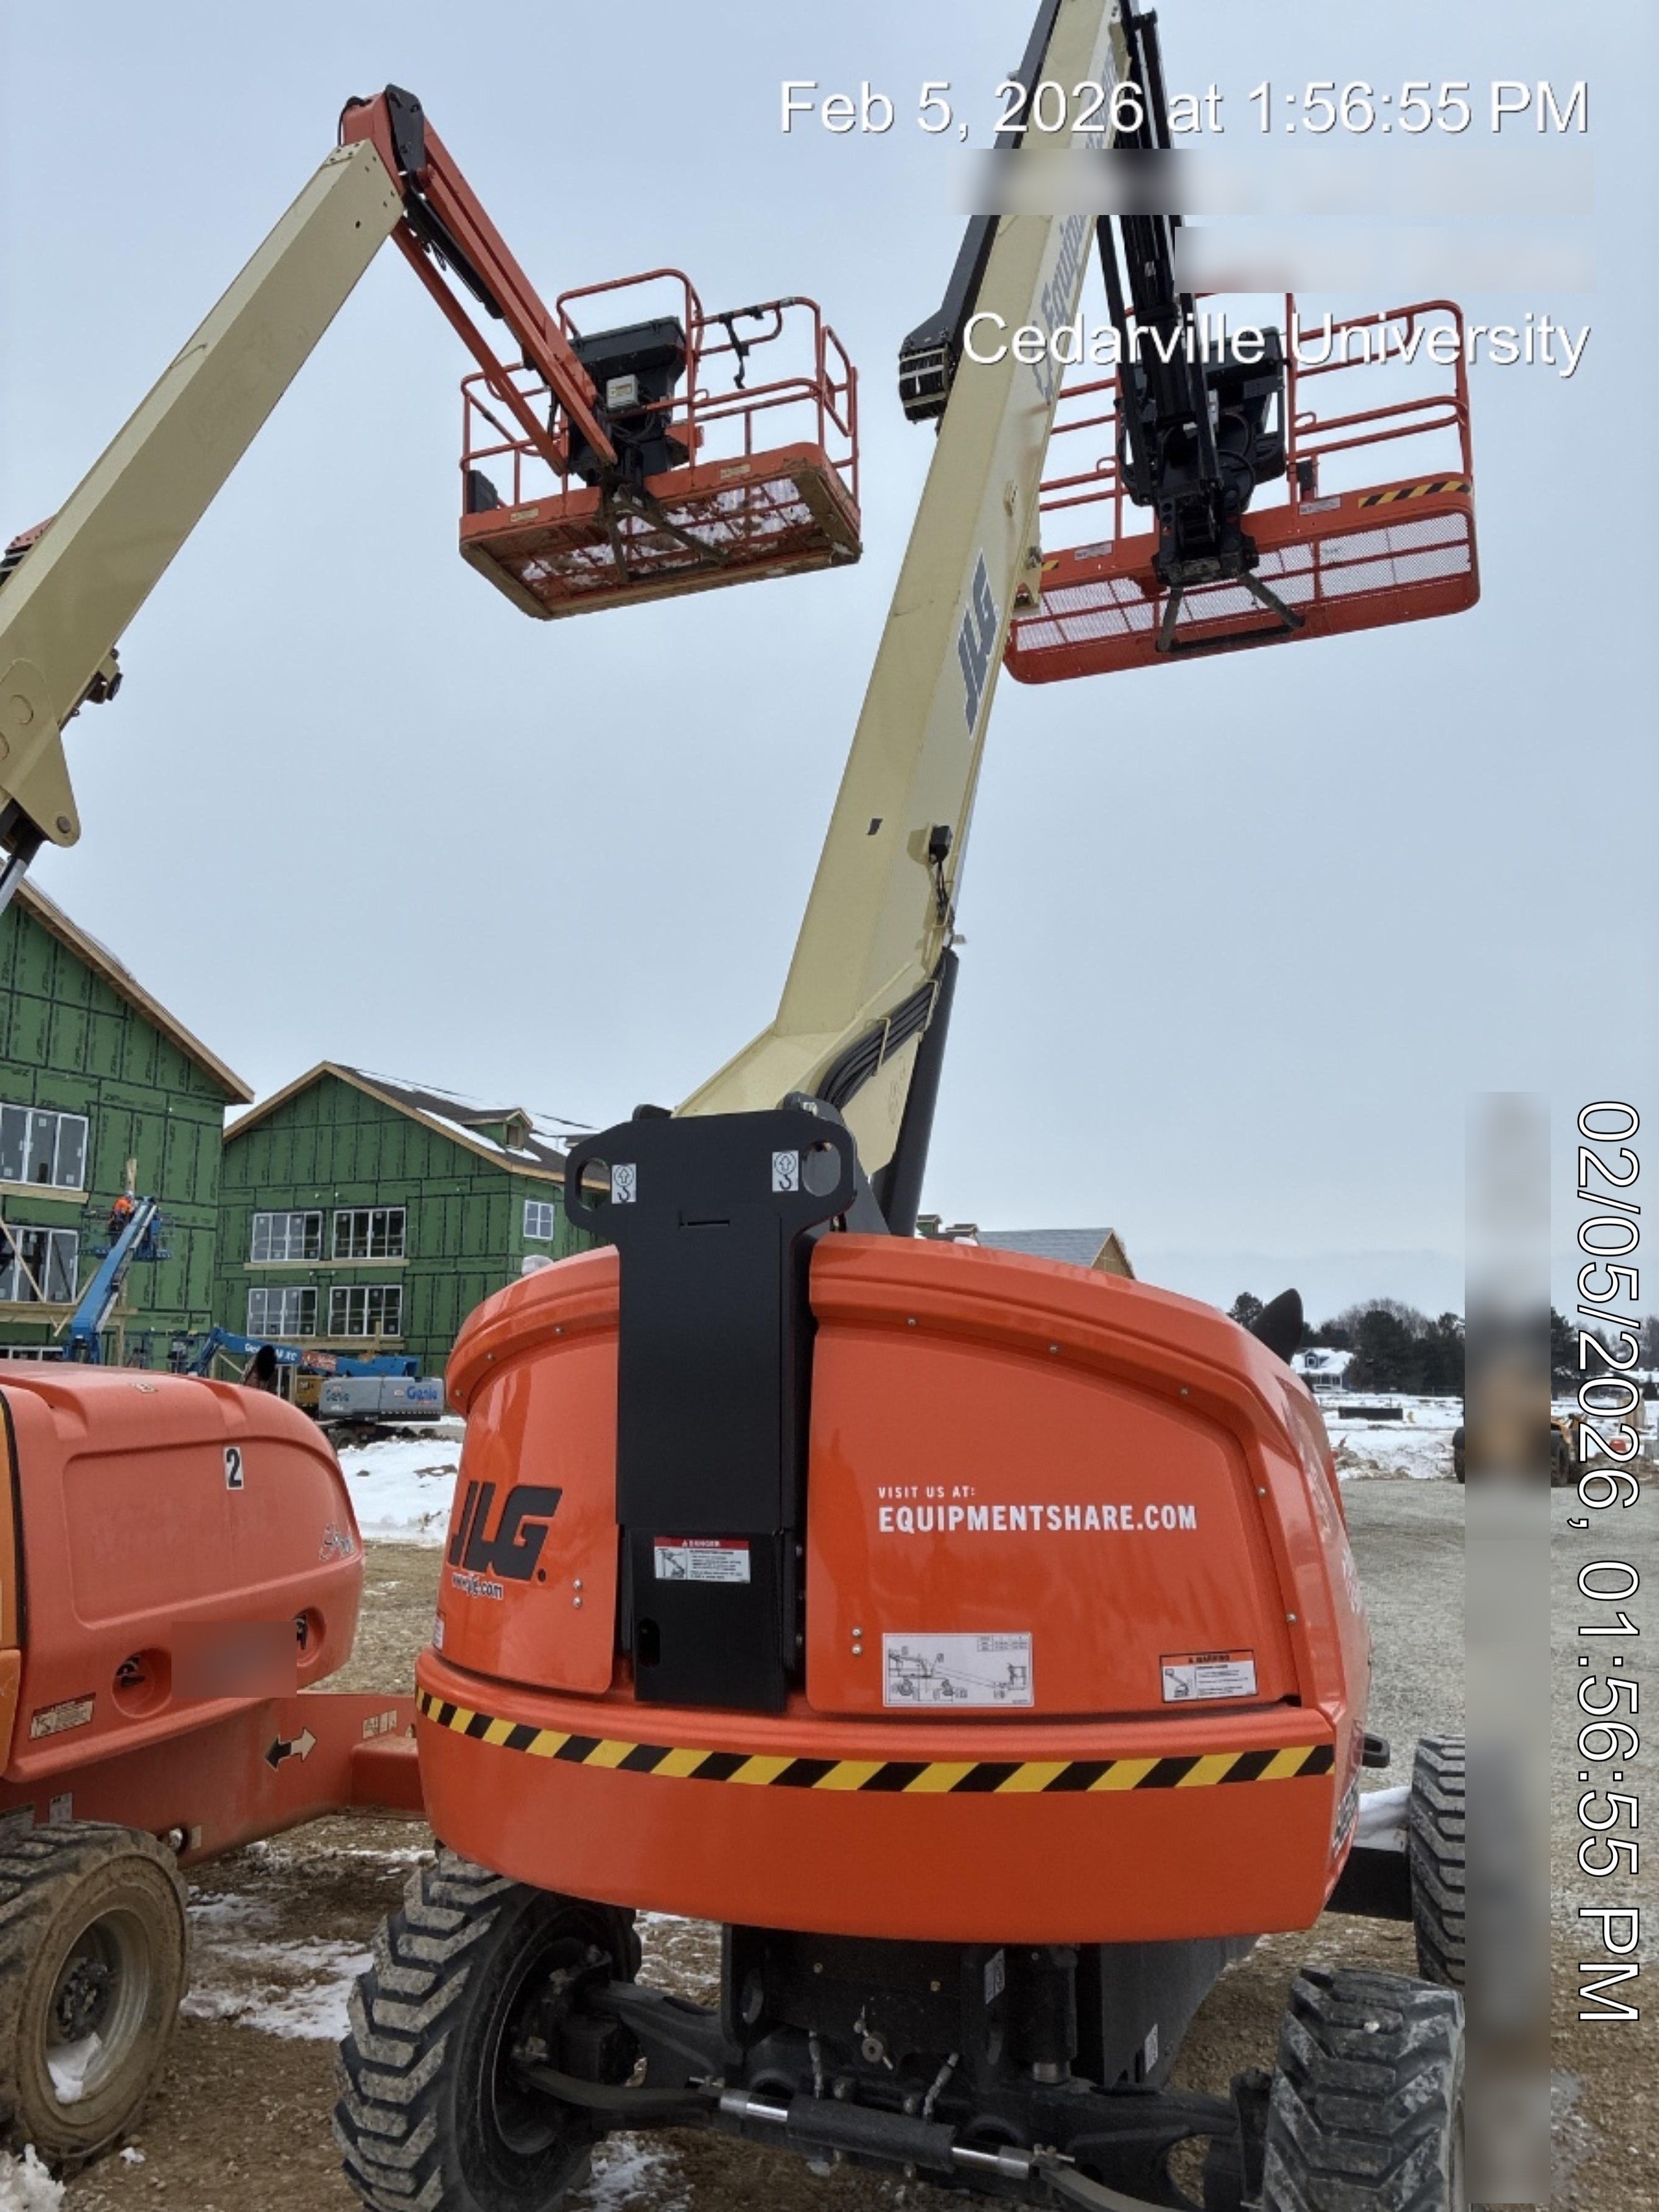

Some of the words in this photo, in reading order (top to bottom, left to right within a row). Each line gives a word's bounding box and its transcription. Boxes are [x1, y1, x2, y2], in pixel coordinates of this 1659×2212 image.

[957, 551, 998, 736] JLG
[406, 1386, 437, 1400] Genie
[226, 1448, 242, 1488] 2
[877, 1486, 919, 1499] VISIT
[926, 1486, 945, 1499] US
[952, 1485, 976, 1498] AT:
[449, 1480, 563, 1581] JLG
[878, 1504, 1198, 1534] EQUIPMENTSHARE.COM
